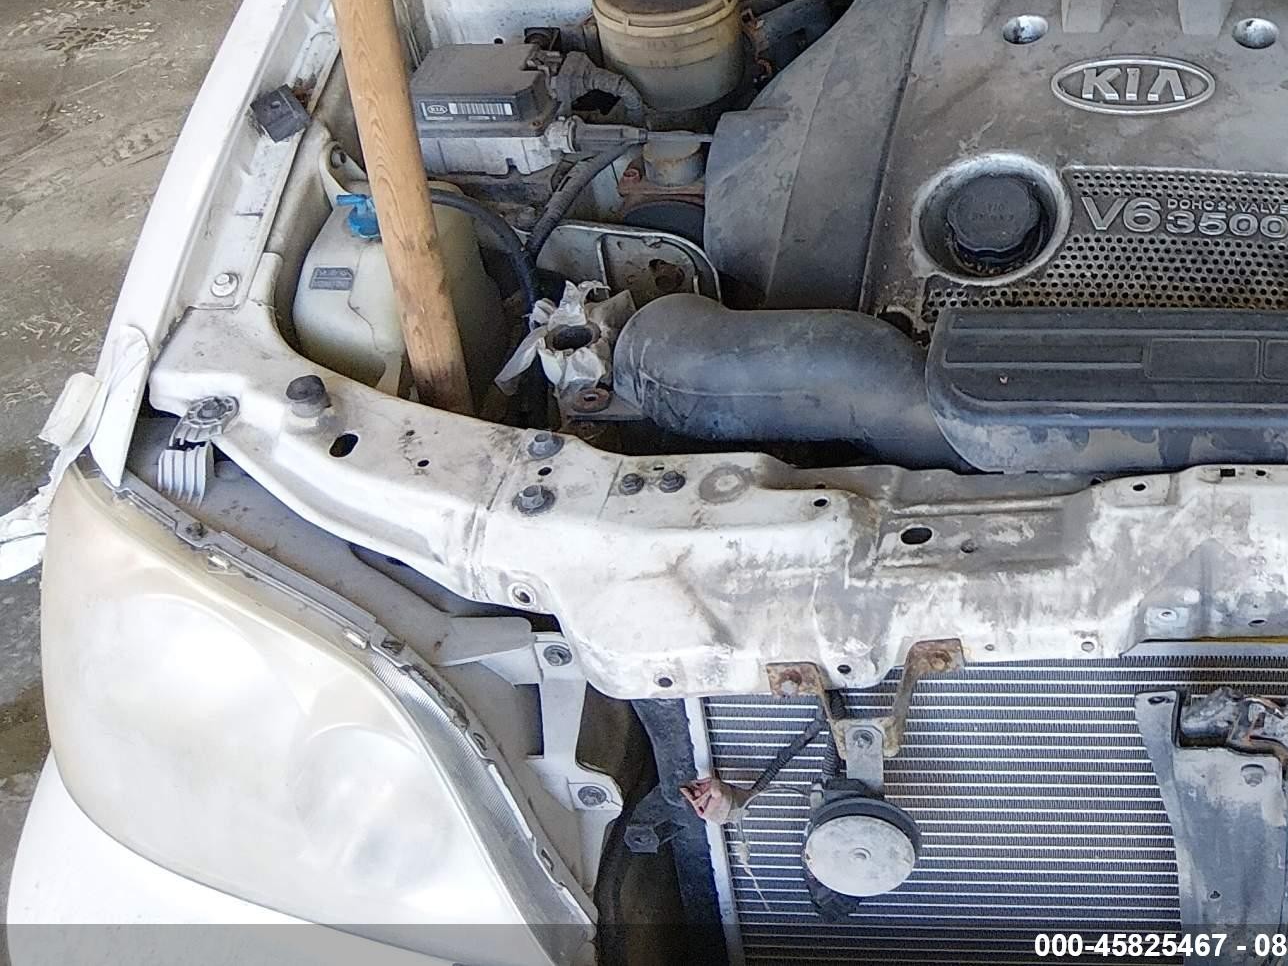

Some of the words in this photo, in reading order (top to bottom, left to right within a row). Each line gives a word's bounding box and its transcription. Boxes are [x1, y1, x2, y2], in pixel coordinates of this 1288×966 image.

[1082, 67, 1186, 102] KIA
[1081, 196, 1162, 233] V6
[1167, 198, 1215, 211] DOHC
